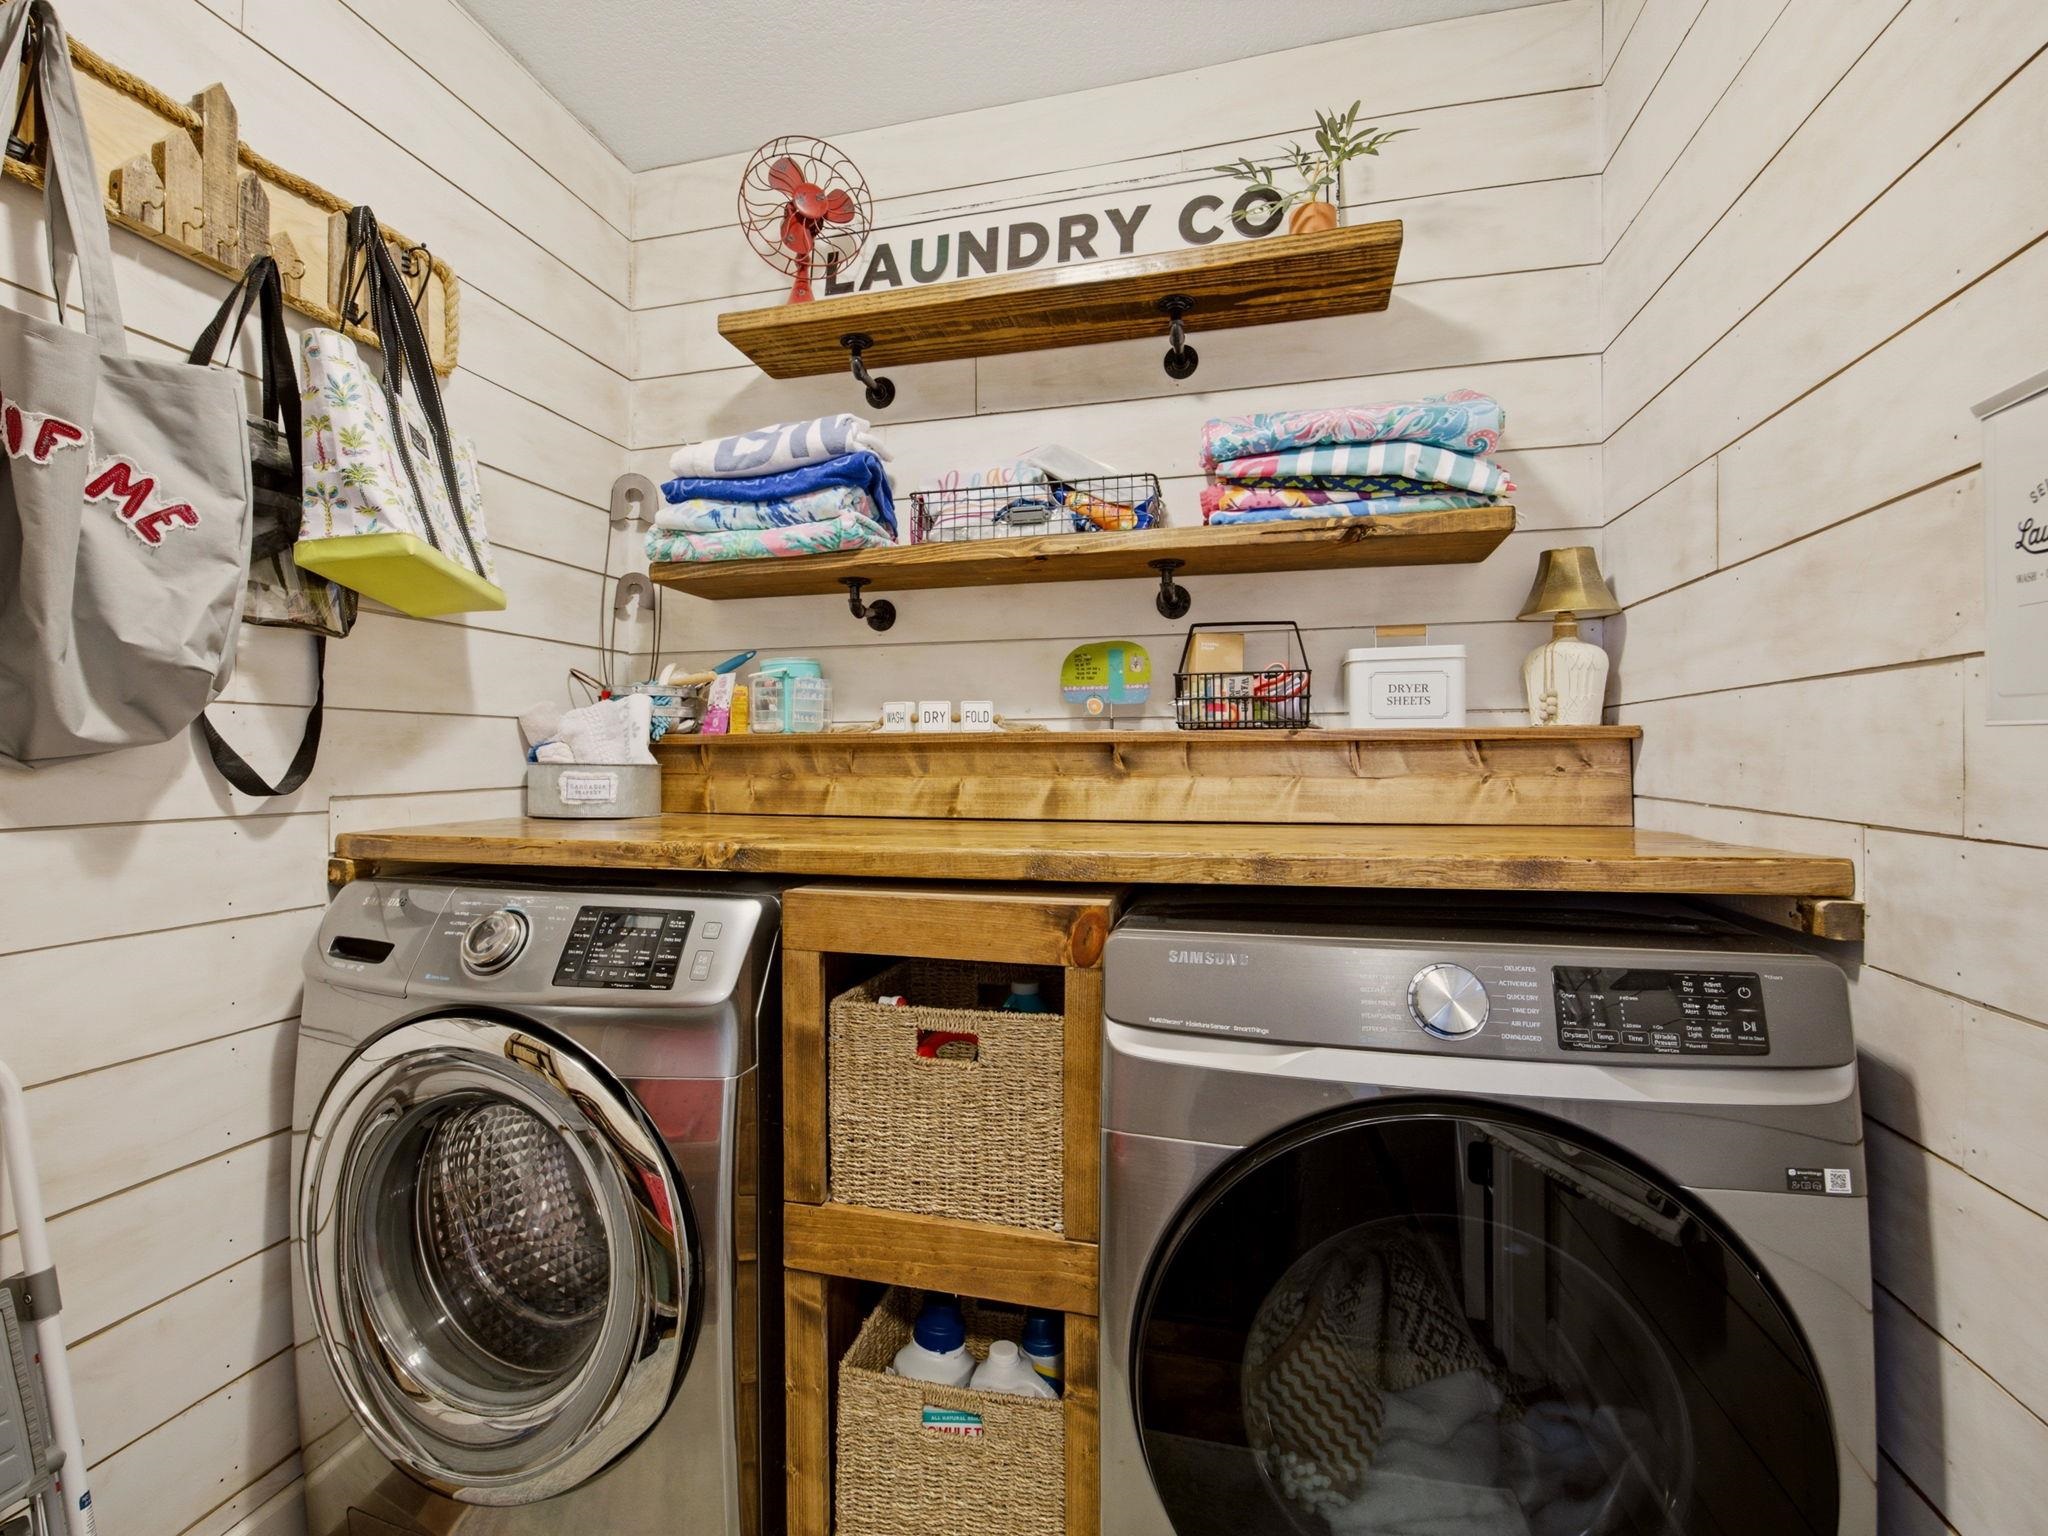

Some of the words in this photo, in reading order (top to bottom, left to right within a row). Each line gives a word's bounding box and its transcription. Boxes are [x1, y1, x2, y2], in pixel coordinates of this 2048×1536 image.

[824, 204, 1152, 296] LAUNDRY
[1178, 188, 1284, 245] CO
[84, 462, 200, 544] ME
[1388, 684, 1429, 693] DRYER
[1386, 696, 1431, 706] SHEETS
[886, 711, 905, 724] WASH
[924, 711, 946, 724] DRY
[965, 711, 989, 724] FOLD
[1168, 950, 1249, 966] SAMSUNG
[1506, 993, 1525, 1001] QUICK
